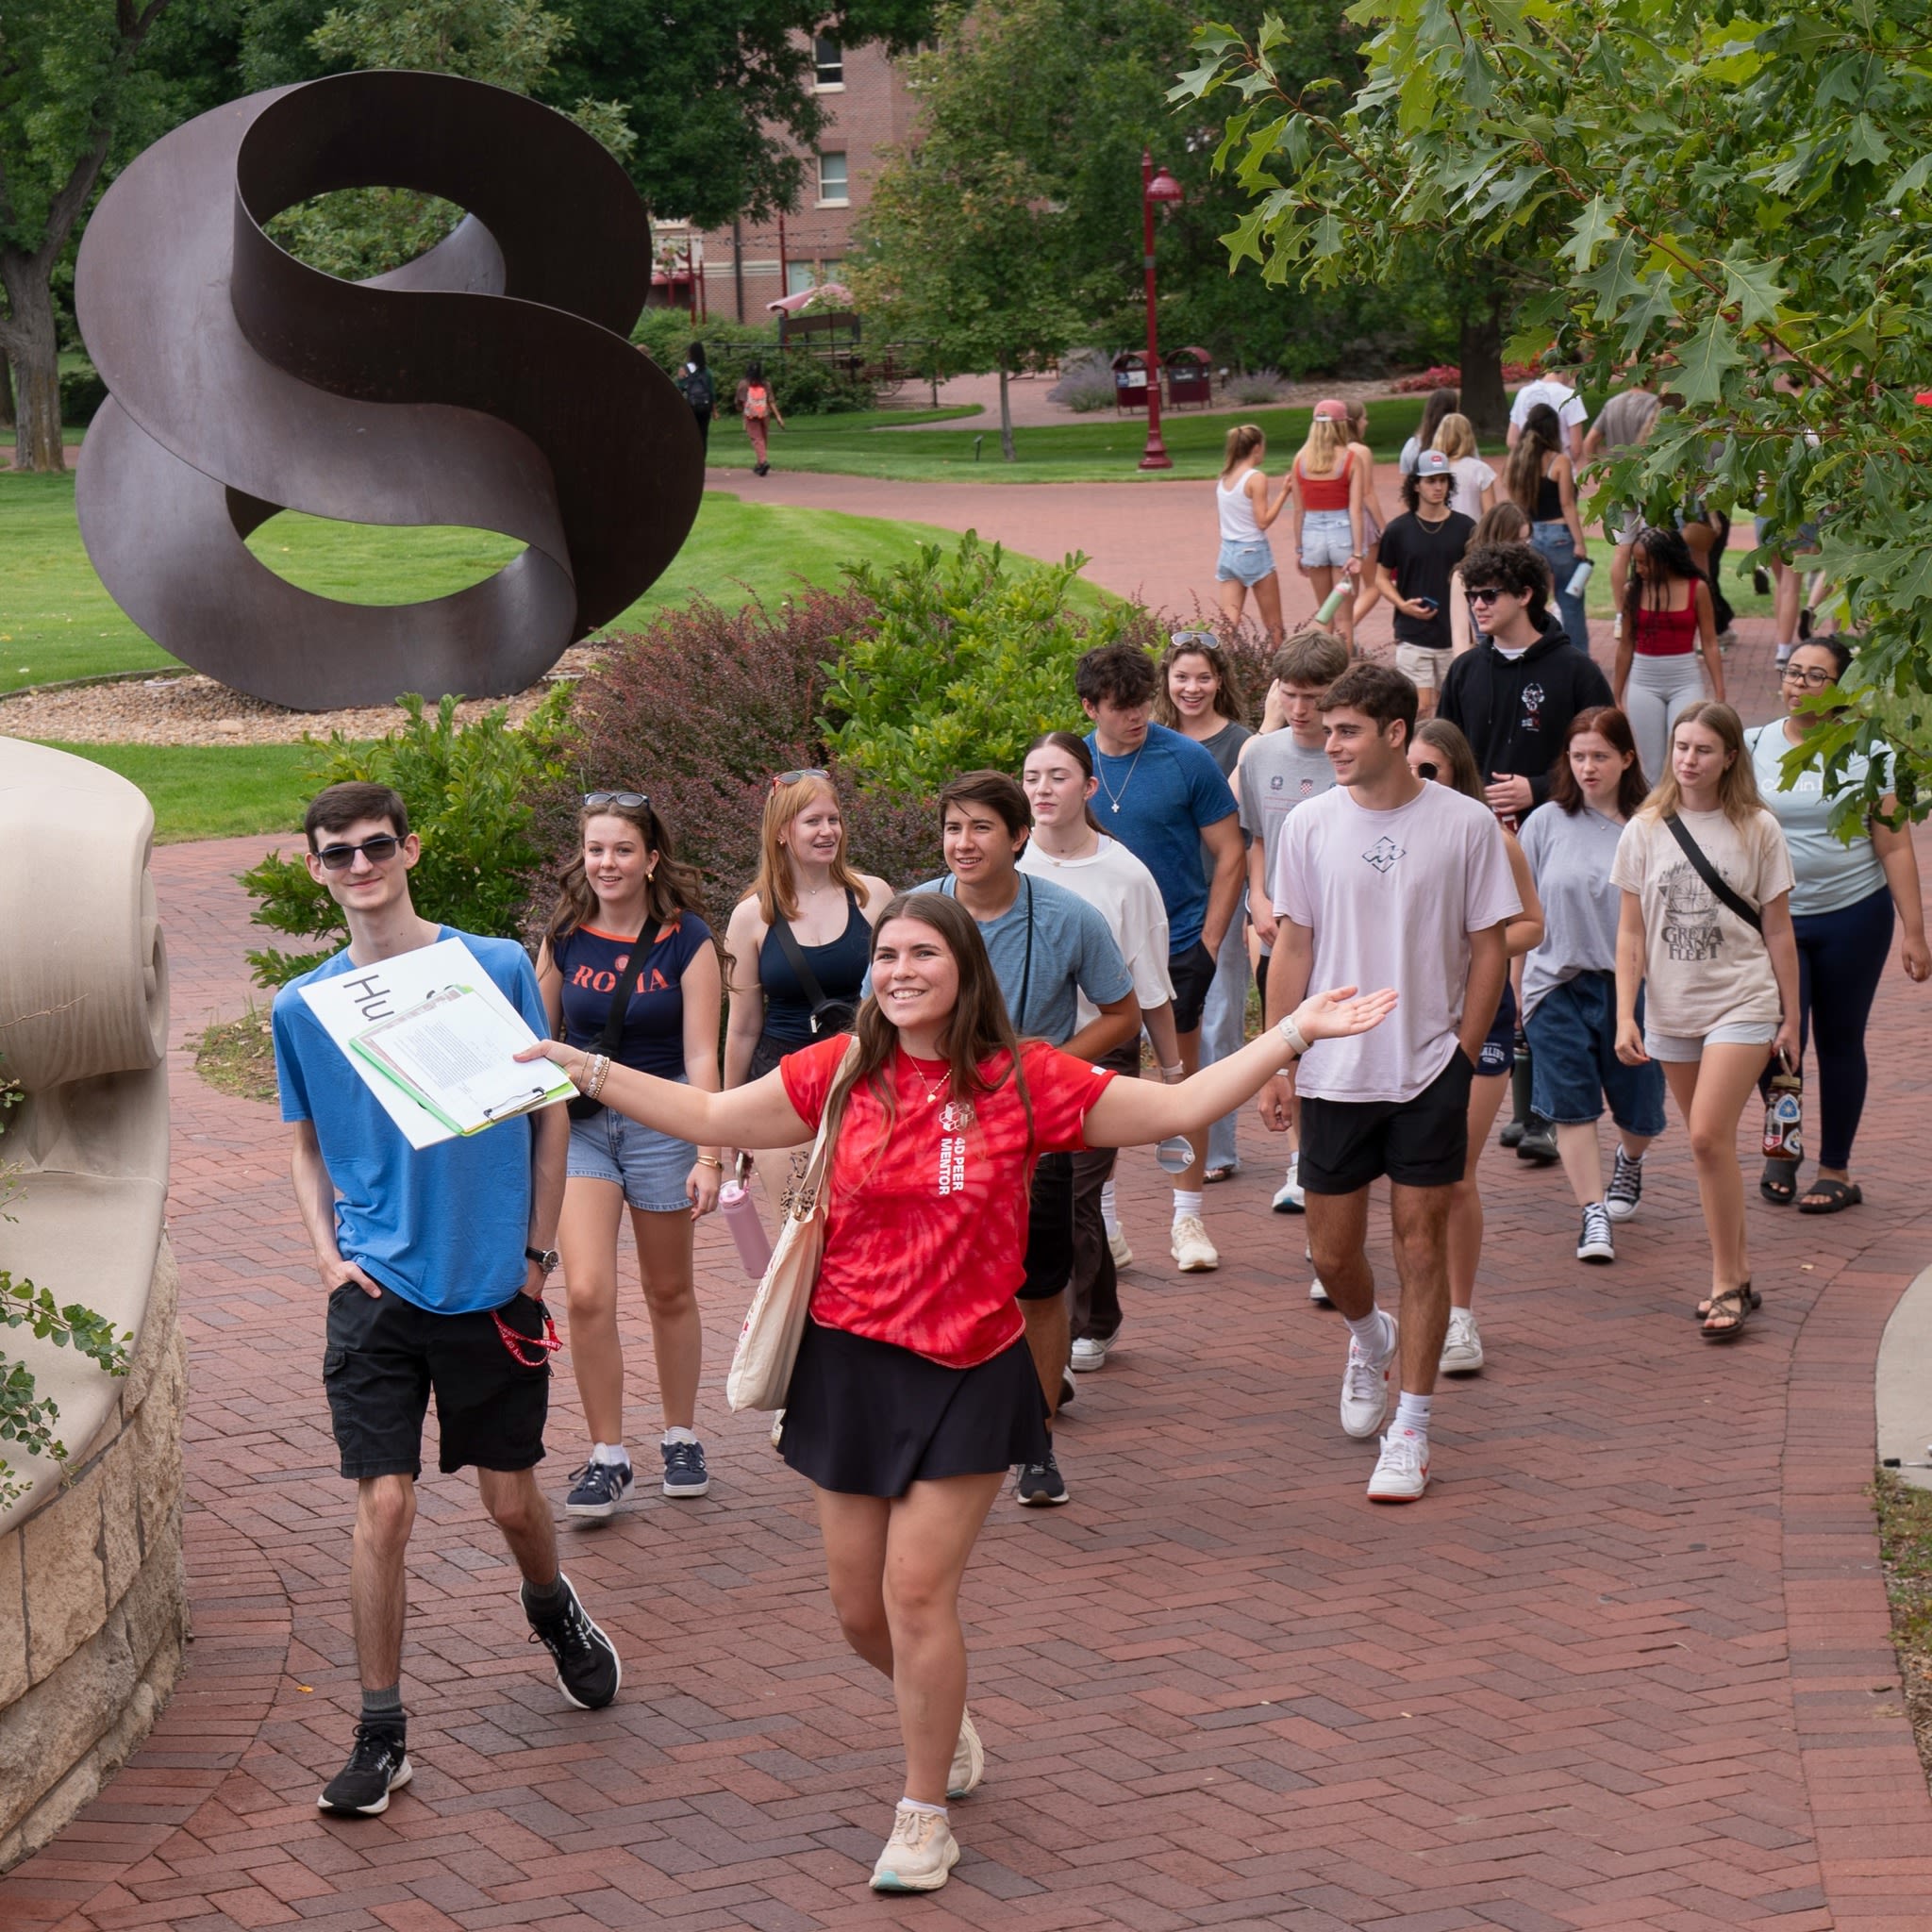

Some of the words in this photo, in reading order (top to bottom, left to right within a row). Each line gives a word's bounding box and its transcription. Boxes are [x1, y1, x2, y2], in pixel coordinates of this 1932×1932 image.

[1660, 925, 1724, 943] GRETA
[1669, 942, 1721, 960] FLEET
[954, 1137, 965, 1155] 4D
[939, 1138, 952, 1195] MENTOR
[953, 1157, 965, 1191] PEER
